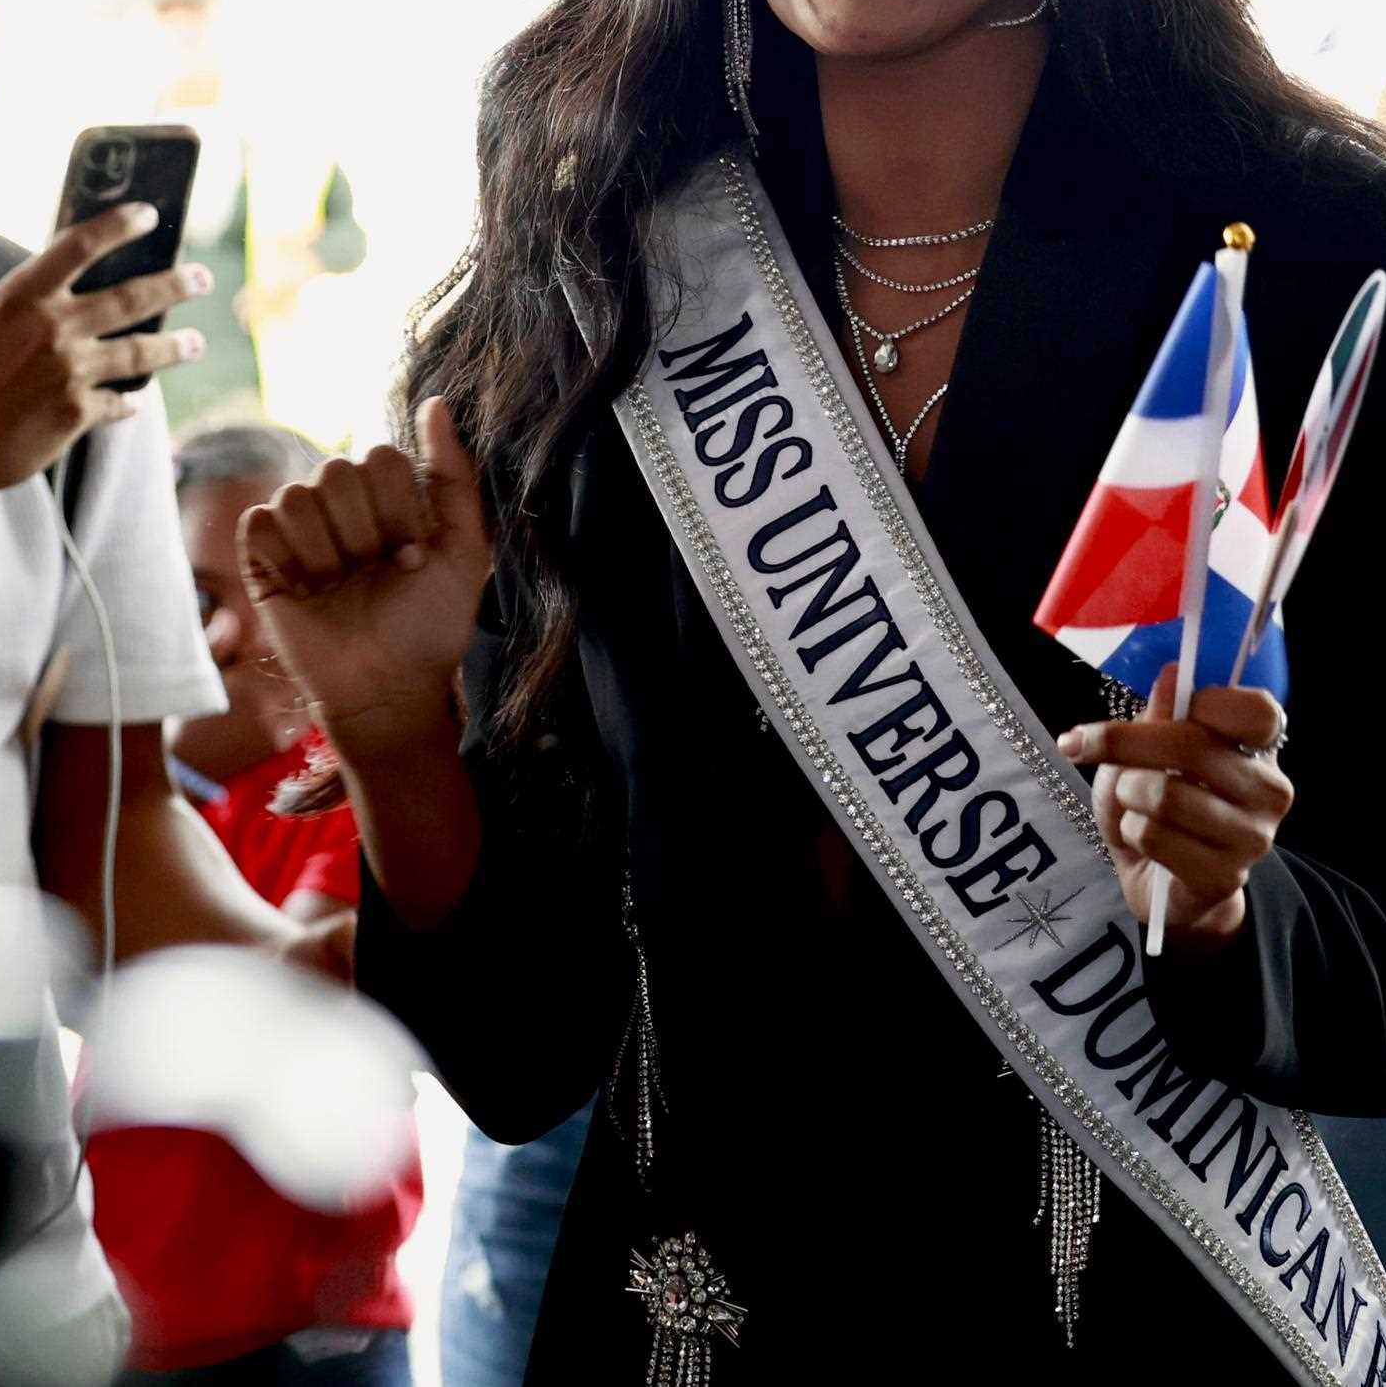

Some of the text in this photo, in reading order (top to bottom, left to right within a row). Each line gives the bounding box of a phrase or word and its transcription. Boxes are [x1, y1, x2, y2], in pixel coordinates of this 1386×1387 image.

[658, 310, 814, 509] MISS
[746, 484, 1058, 919] UNIVERSE
[1030, 920, 1368, 1367] DOMINICAN
